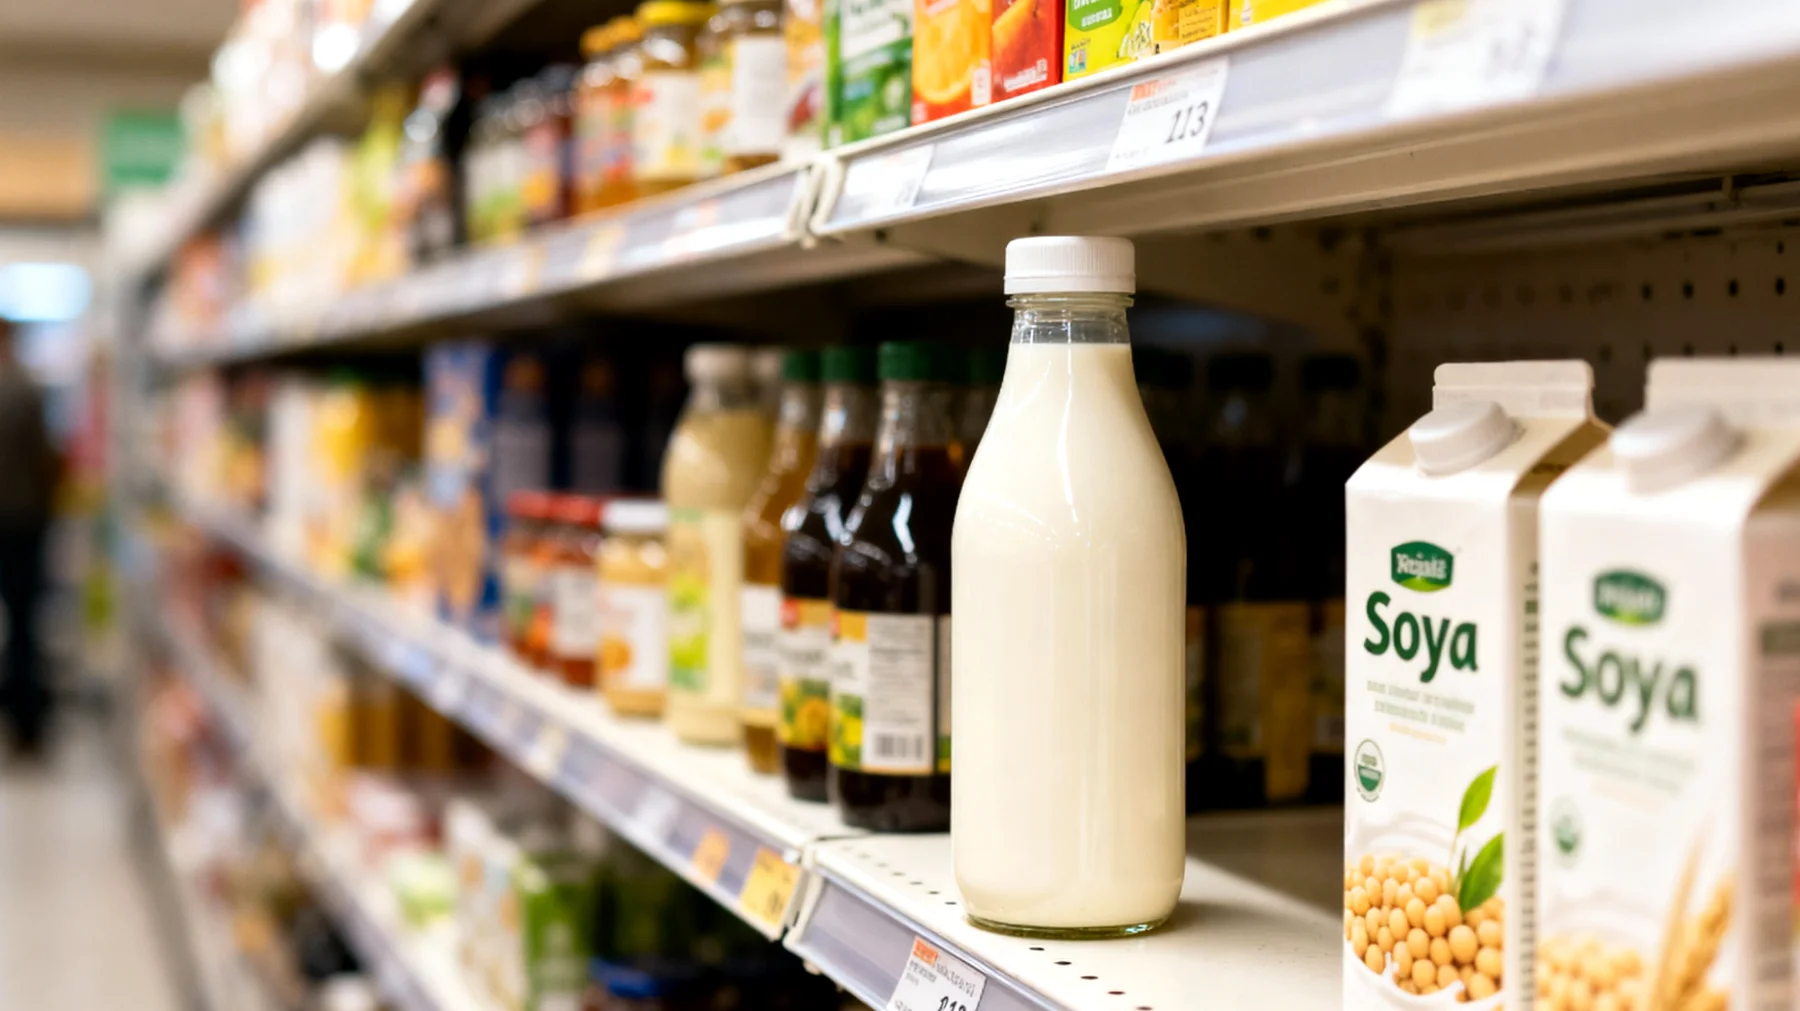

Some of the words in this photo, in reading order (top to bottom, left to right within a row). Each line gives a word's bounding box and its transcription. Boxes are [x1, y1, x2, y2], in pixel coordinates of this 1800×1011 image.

[1165, 101, 1208, 144] 113
[1364, 591, 1478, 683] Soya
[1560, 626, 1698, 734] Soya
